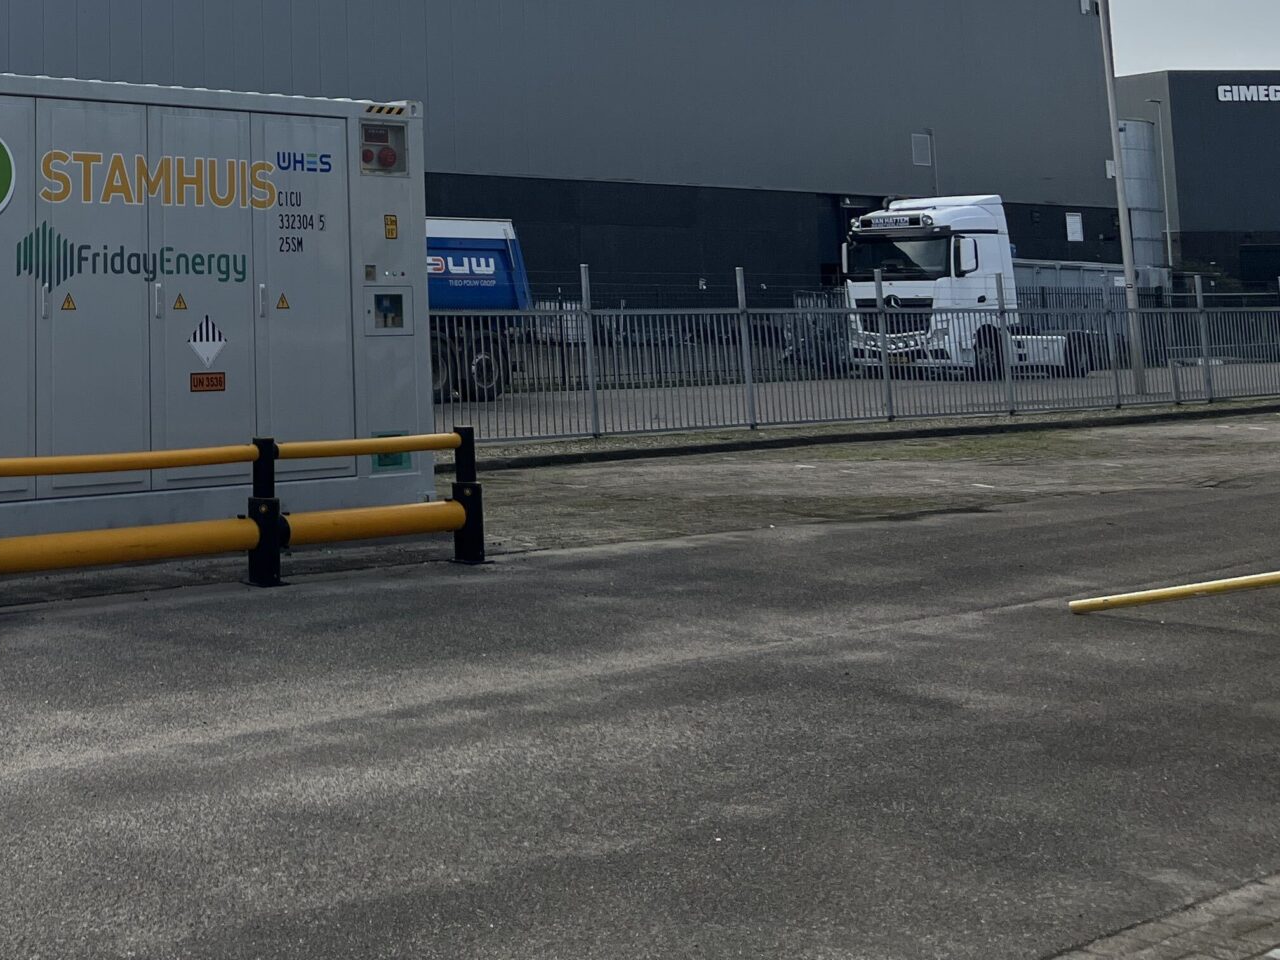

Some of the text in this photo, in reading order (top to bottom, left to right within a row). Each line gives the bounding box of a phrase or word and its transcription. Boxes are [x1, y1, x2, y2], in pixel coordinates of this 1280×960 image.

[1217, 85, 1280, 101] GIMEG
[39, 150, 277, 210] STAMHUIS
[277, 191, 302, 207] CICU
[278, 214, 326, 231] 332304 5
[279, 237, 304, 253] 25SM
[77, 245, 246, 283] FridayEnergy
[193, 376, 204, 387] UN
